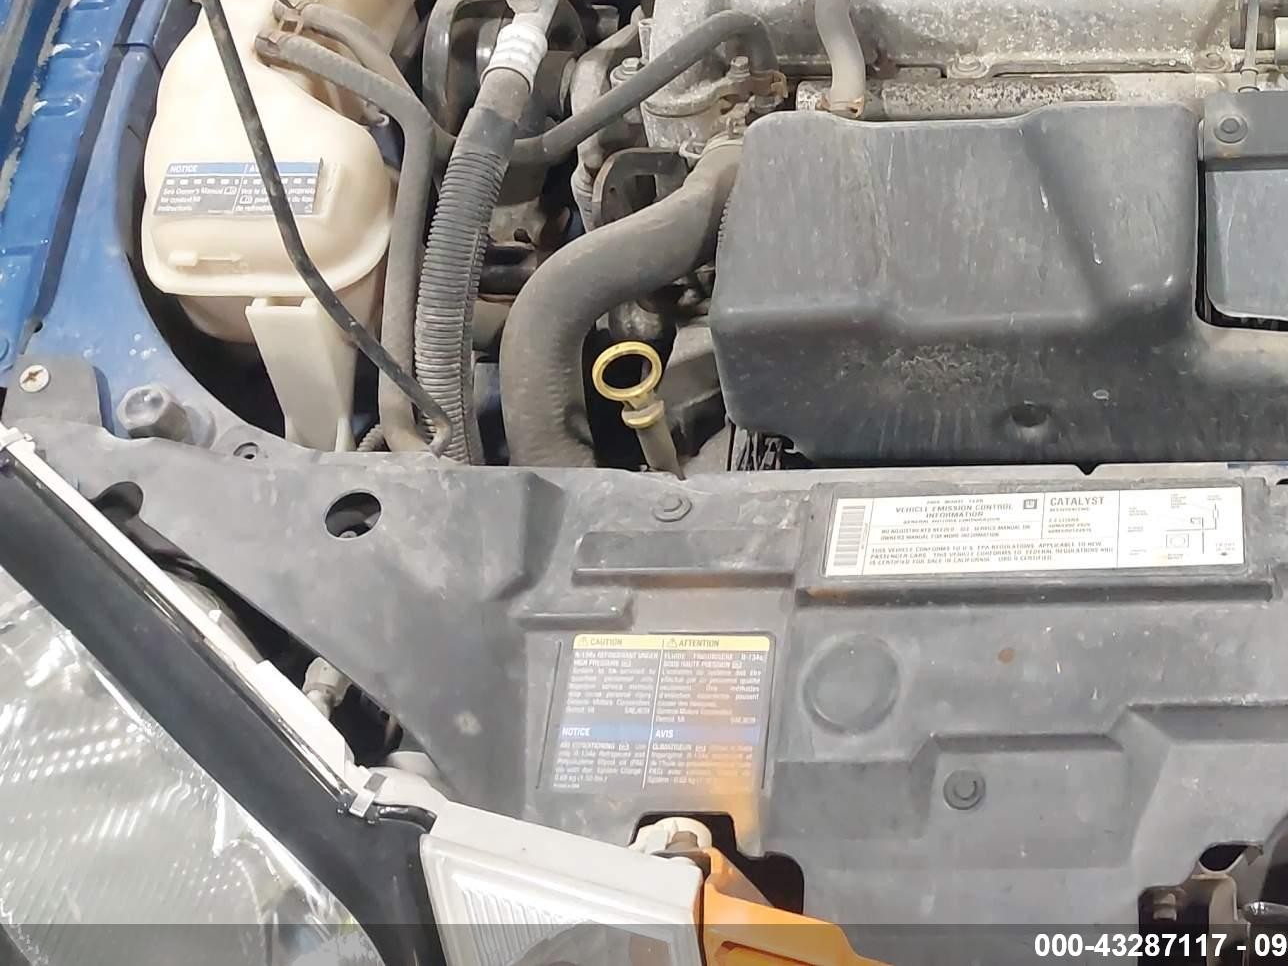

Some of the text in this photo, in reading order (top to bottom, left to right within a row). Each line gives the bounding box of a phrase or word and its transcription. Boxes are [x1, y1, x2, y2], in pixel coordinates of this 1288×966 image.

[170, 164, 198, 173] NOTICE
[1050, 496, 1104, 506] CATALYST
[590, 638, 623, 646] CAUTION
[562, 727, 591, 736] NOTICE
[655, 730, 674, 738] AVIS
